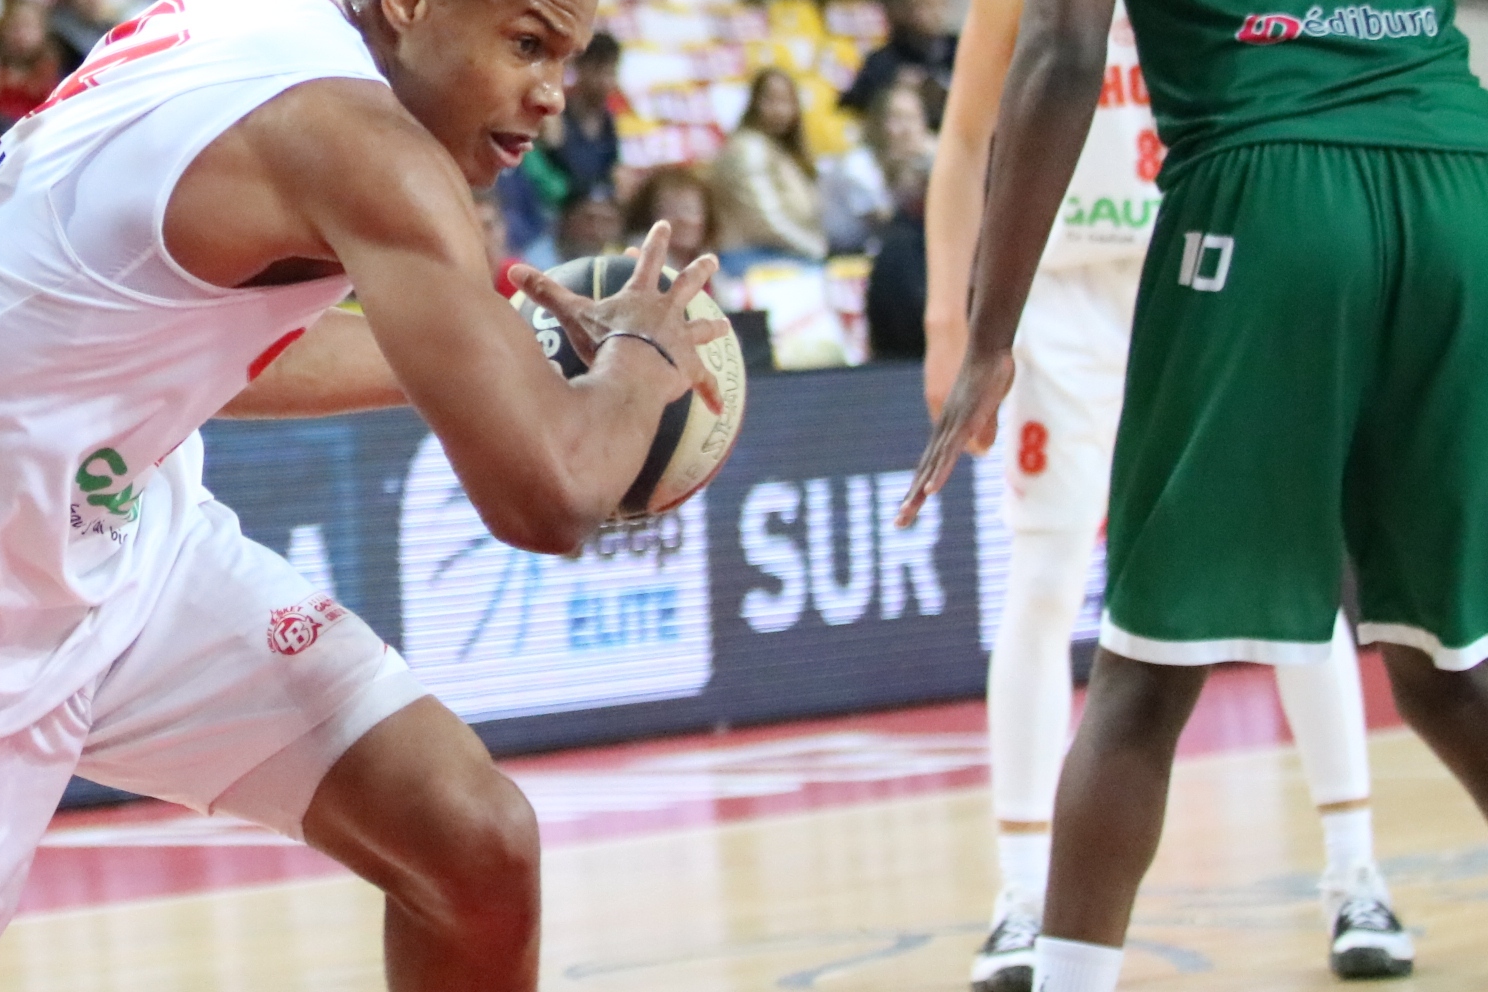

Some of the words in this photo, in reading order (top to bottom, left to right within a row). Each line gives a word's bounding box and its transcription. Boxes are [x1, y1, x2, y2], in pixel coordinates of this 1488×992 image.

[1178, 231, 1233, 292] 10
[1016, 420, 1050, 476] 8
[738, 470, 947, 634] SUR
